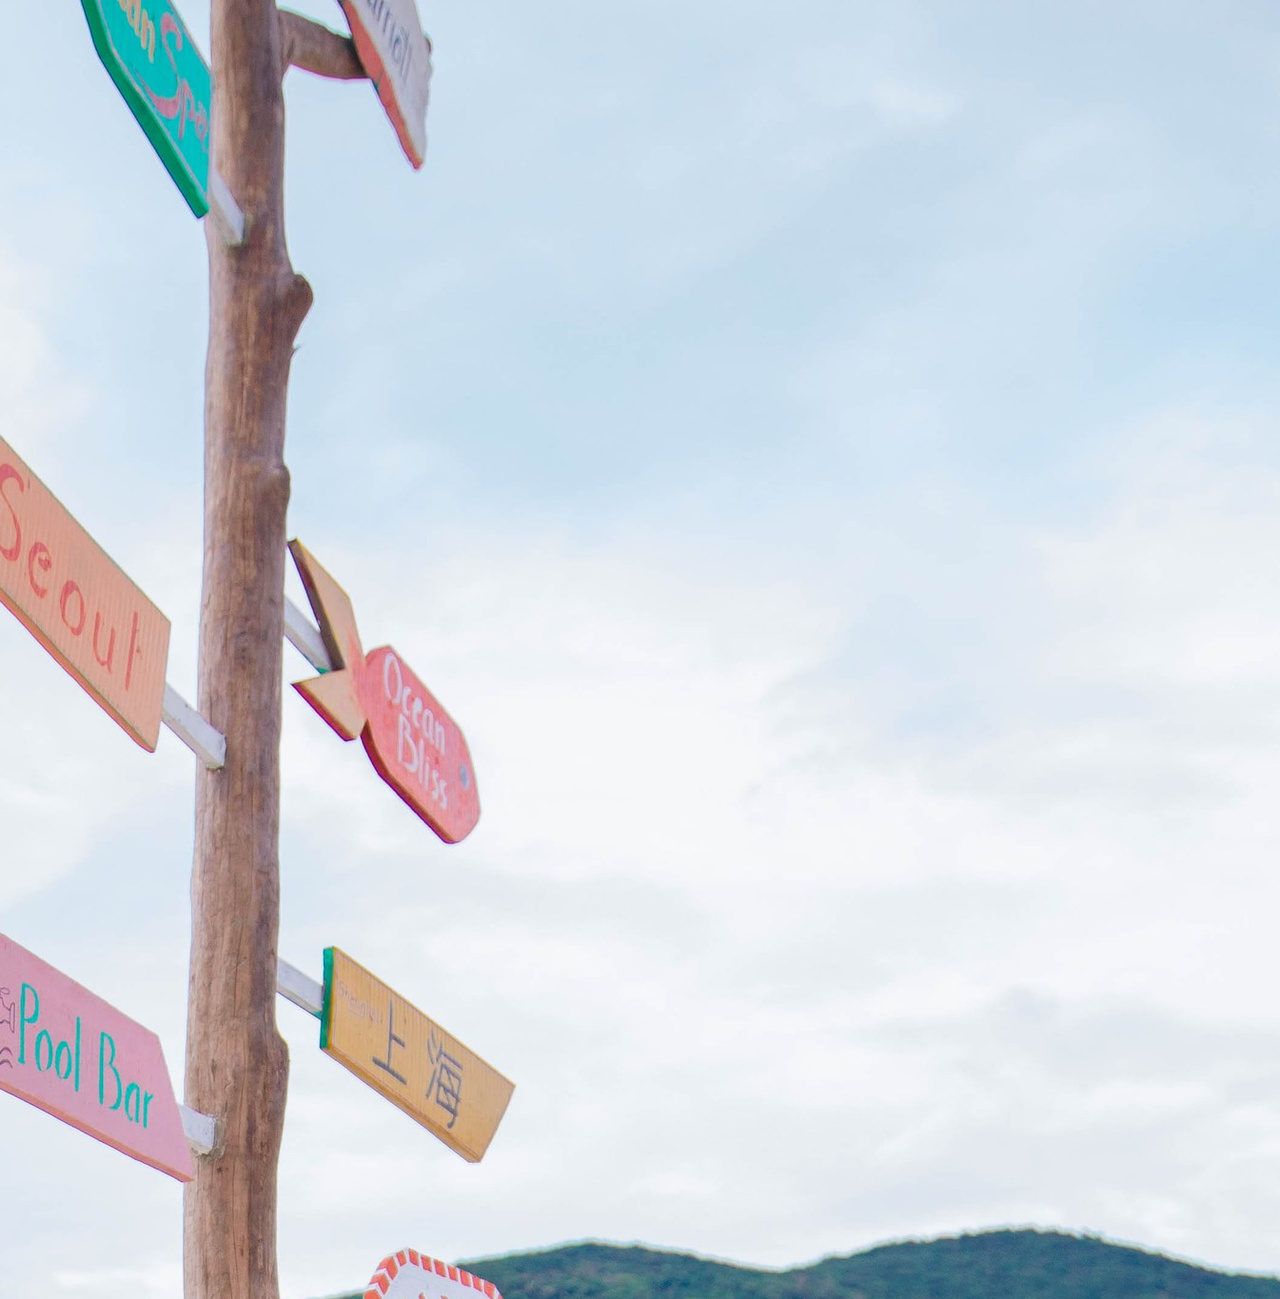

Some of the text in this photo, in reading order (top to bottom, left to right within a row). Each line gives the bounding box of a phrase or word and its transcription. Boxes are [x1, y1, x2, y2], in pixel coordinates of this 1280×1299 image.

[383, 652, 446, 756] Ocean
[397, 713, 448, 810] Bliss
[17, 982, 154, 1129] Pool Bar
[372, 998, 464, 1129] 上海
